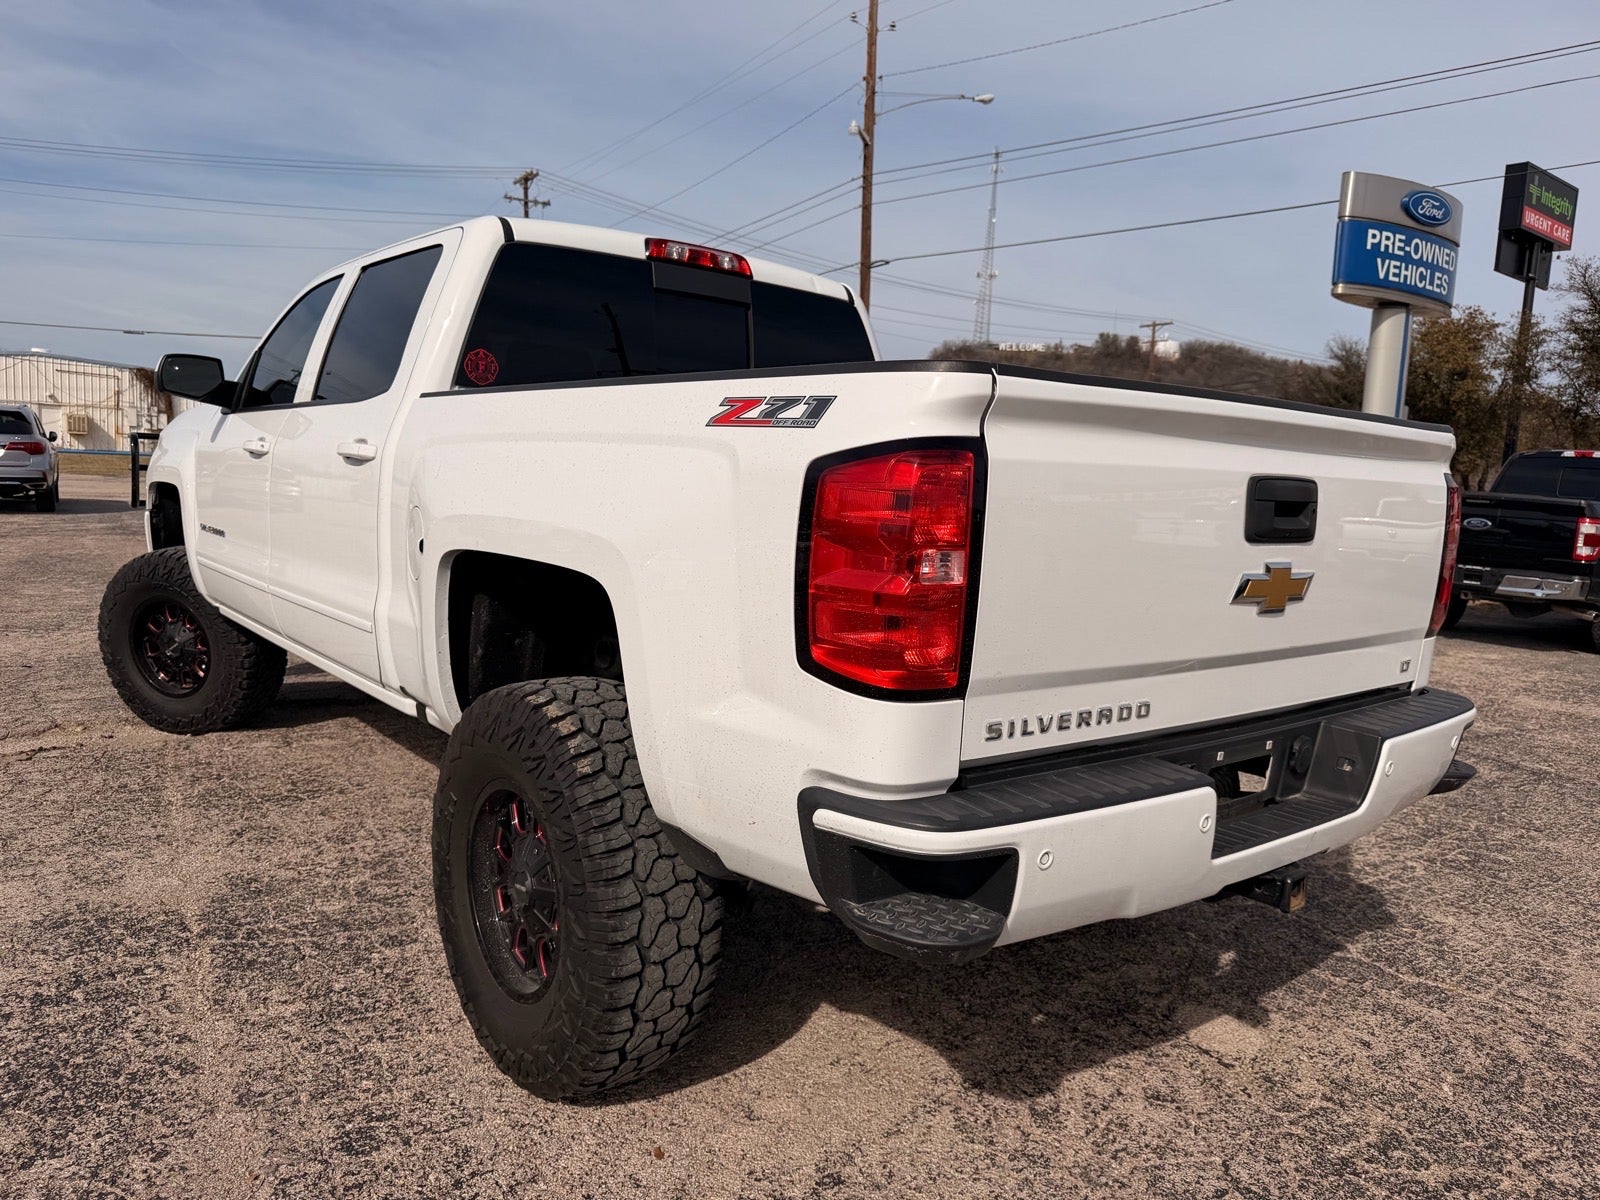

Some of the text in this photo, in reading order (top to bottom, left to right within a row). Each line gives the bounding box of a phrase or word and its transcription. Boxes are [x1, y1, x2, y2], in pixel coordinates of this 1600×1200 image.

[1418, 198, 1445, 219] Ford
[1541, 186, 1573, 220] Integrity
[1525, 210, 1570, 242] URGENT CARE
[1366, 229, 1456, 272] PRE-OWNED
[1376, 257, 1449, 296] VEHICLES
[998, 342, 1047, 352] WELCOME
[705, 396, 837, 428] Z71
[984, 700, 1151, 742] SILVERADO
